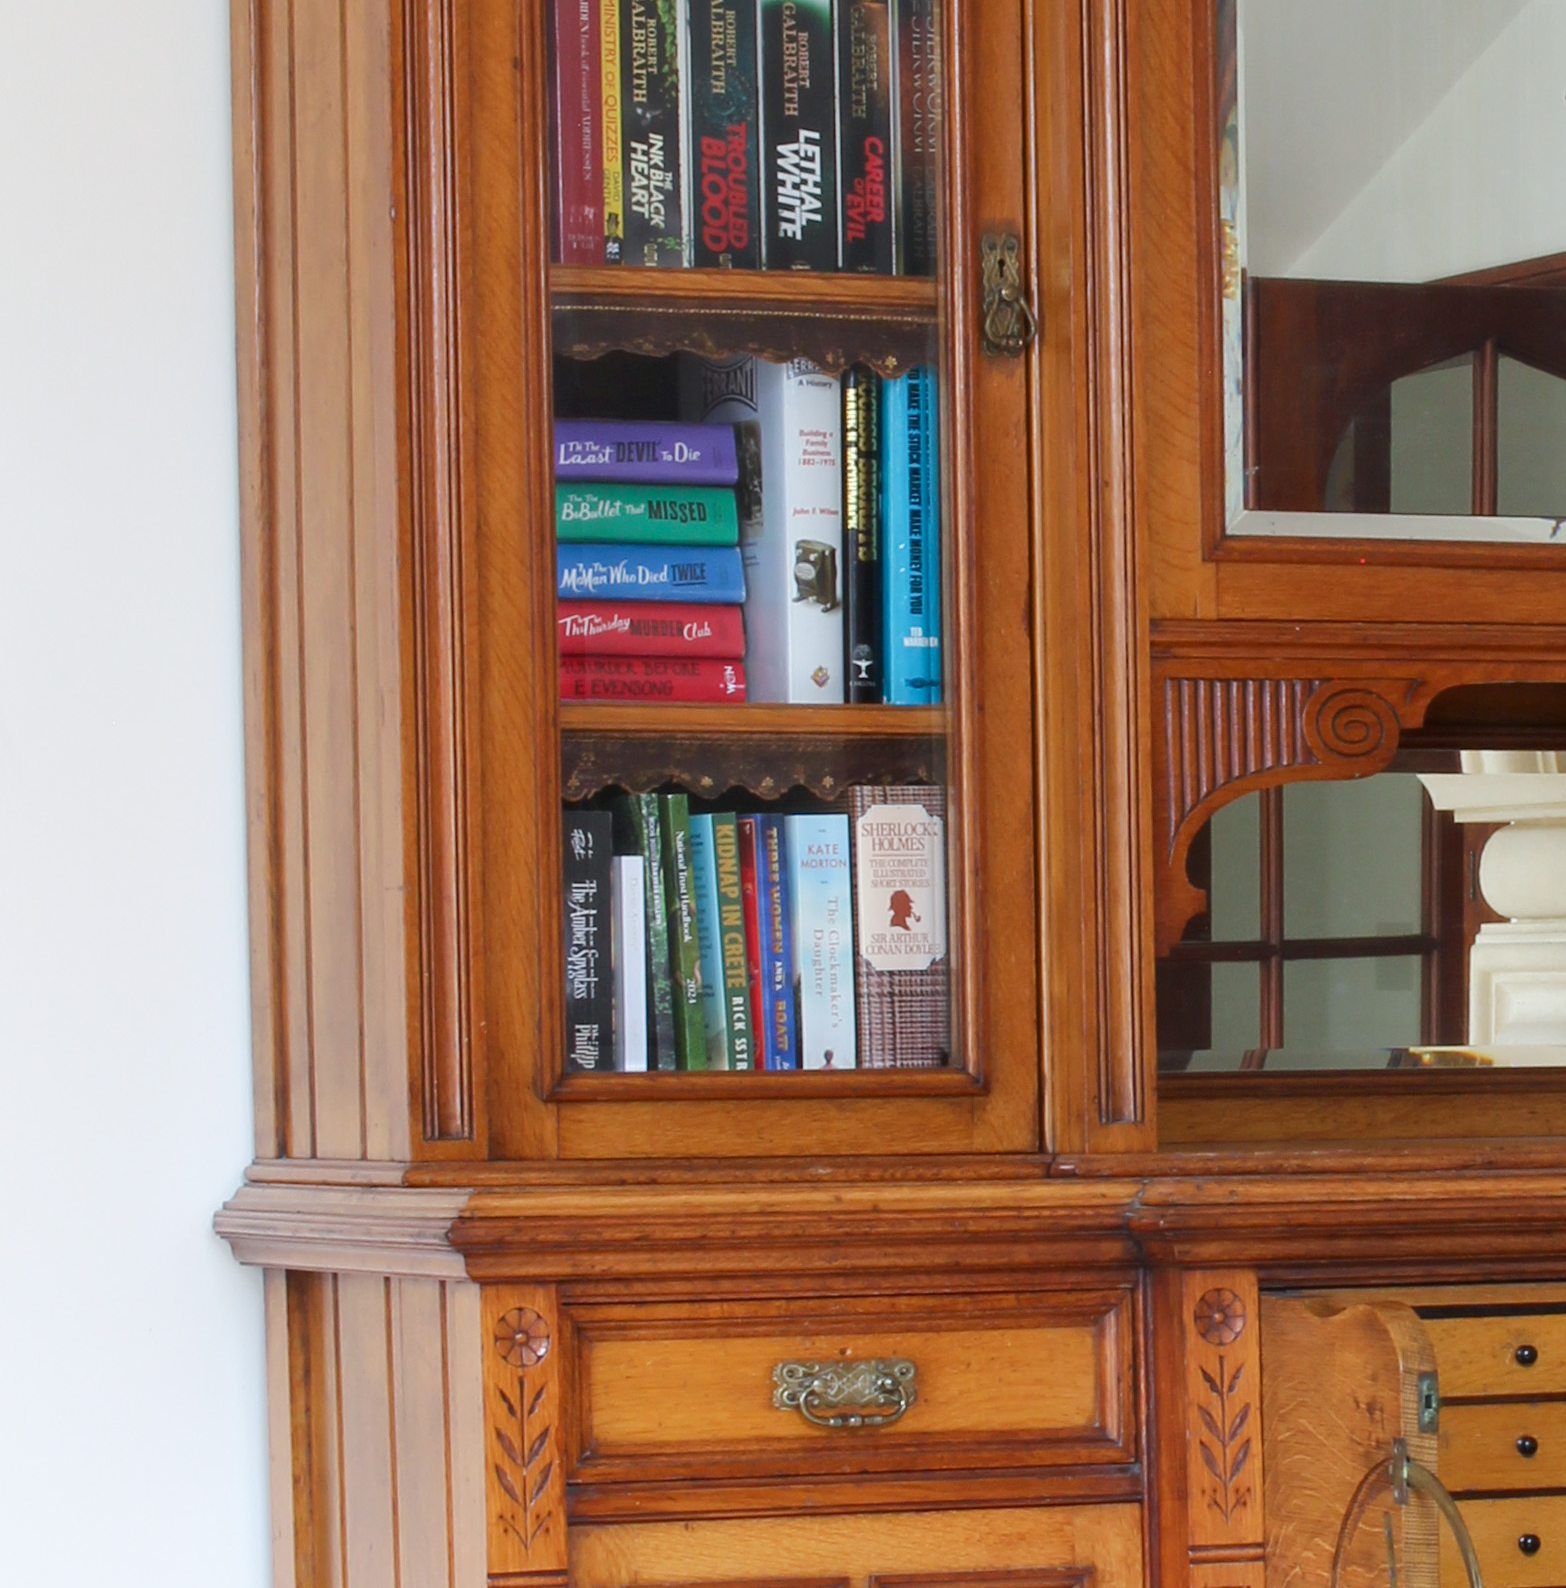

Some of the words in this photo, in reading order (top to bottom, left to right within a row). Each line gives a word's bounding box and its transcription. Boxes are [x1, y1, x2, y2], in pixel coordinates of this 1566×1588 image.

[647, 19, 657, 75] ROBERT
[726, 10, 737, 66] ROBERT
[782, 1, 799, 117] GALBRAITH
[798, 31, 810, 89] ROBERT
[851, 5, 866, 119] GALBRAITH
[605, 72, 616, 91] OF
[866, 34, 877, 92] ROBERT
[603, 95, 618, 163] QUIZZES
[630, 142, 649, 219] HEART
[701, 135, 728, 253] BLOOD
[727, 121, 747, 249] TROUBLED
[776, 142, 802, 242] WHITE
[798, 128, 822, 223] LETHAL
[864, 136, 885, 223] CAREER
[847, 194, 866, 243] EVIL
[908, 383, 920, 413] MAKE
[908, 414, 920, 432] THE
[615, 442, 659, 463] DEVIL
[674, 442, 700, 463] Die
[909, 433, 921, 464] STOCK
[647, 499, 708, 523] MISSED
[608, 560, 637, 585] Who
[638, 565, 668, 585] Died
[671, 562, 707, 584] TWICE
[683, 621, 712, 641] Club
[591, 679, 673, 697] EVENSONG
[675, 831, 687, 871] National
[716, 823, 740, 899] KIDNAP
[800, 858, 847, 869] MORTON
[807, 844, 839, 855] KATE
[872, 837, 925, 852] HOLMES
[679, 870, 689, 894] Trust
[680, 894, 693, 944] Handbook
[722, 905, 742, 927] IN
[827, 897, 839, 925] The
[724, 935, 747, 989] CRETE
[812, 928, 824, 997] Daughter
[827, 930, 840, 1029] Clockmaker's
[732, 996, 747, 1030] RICK
